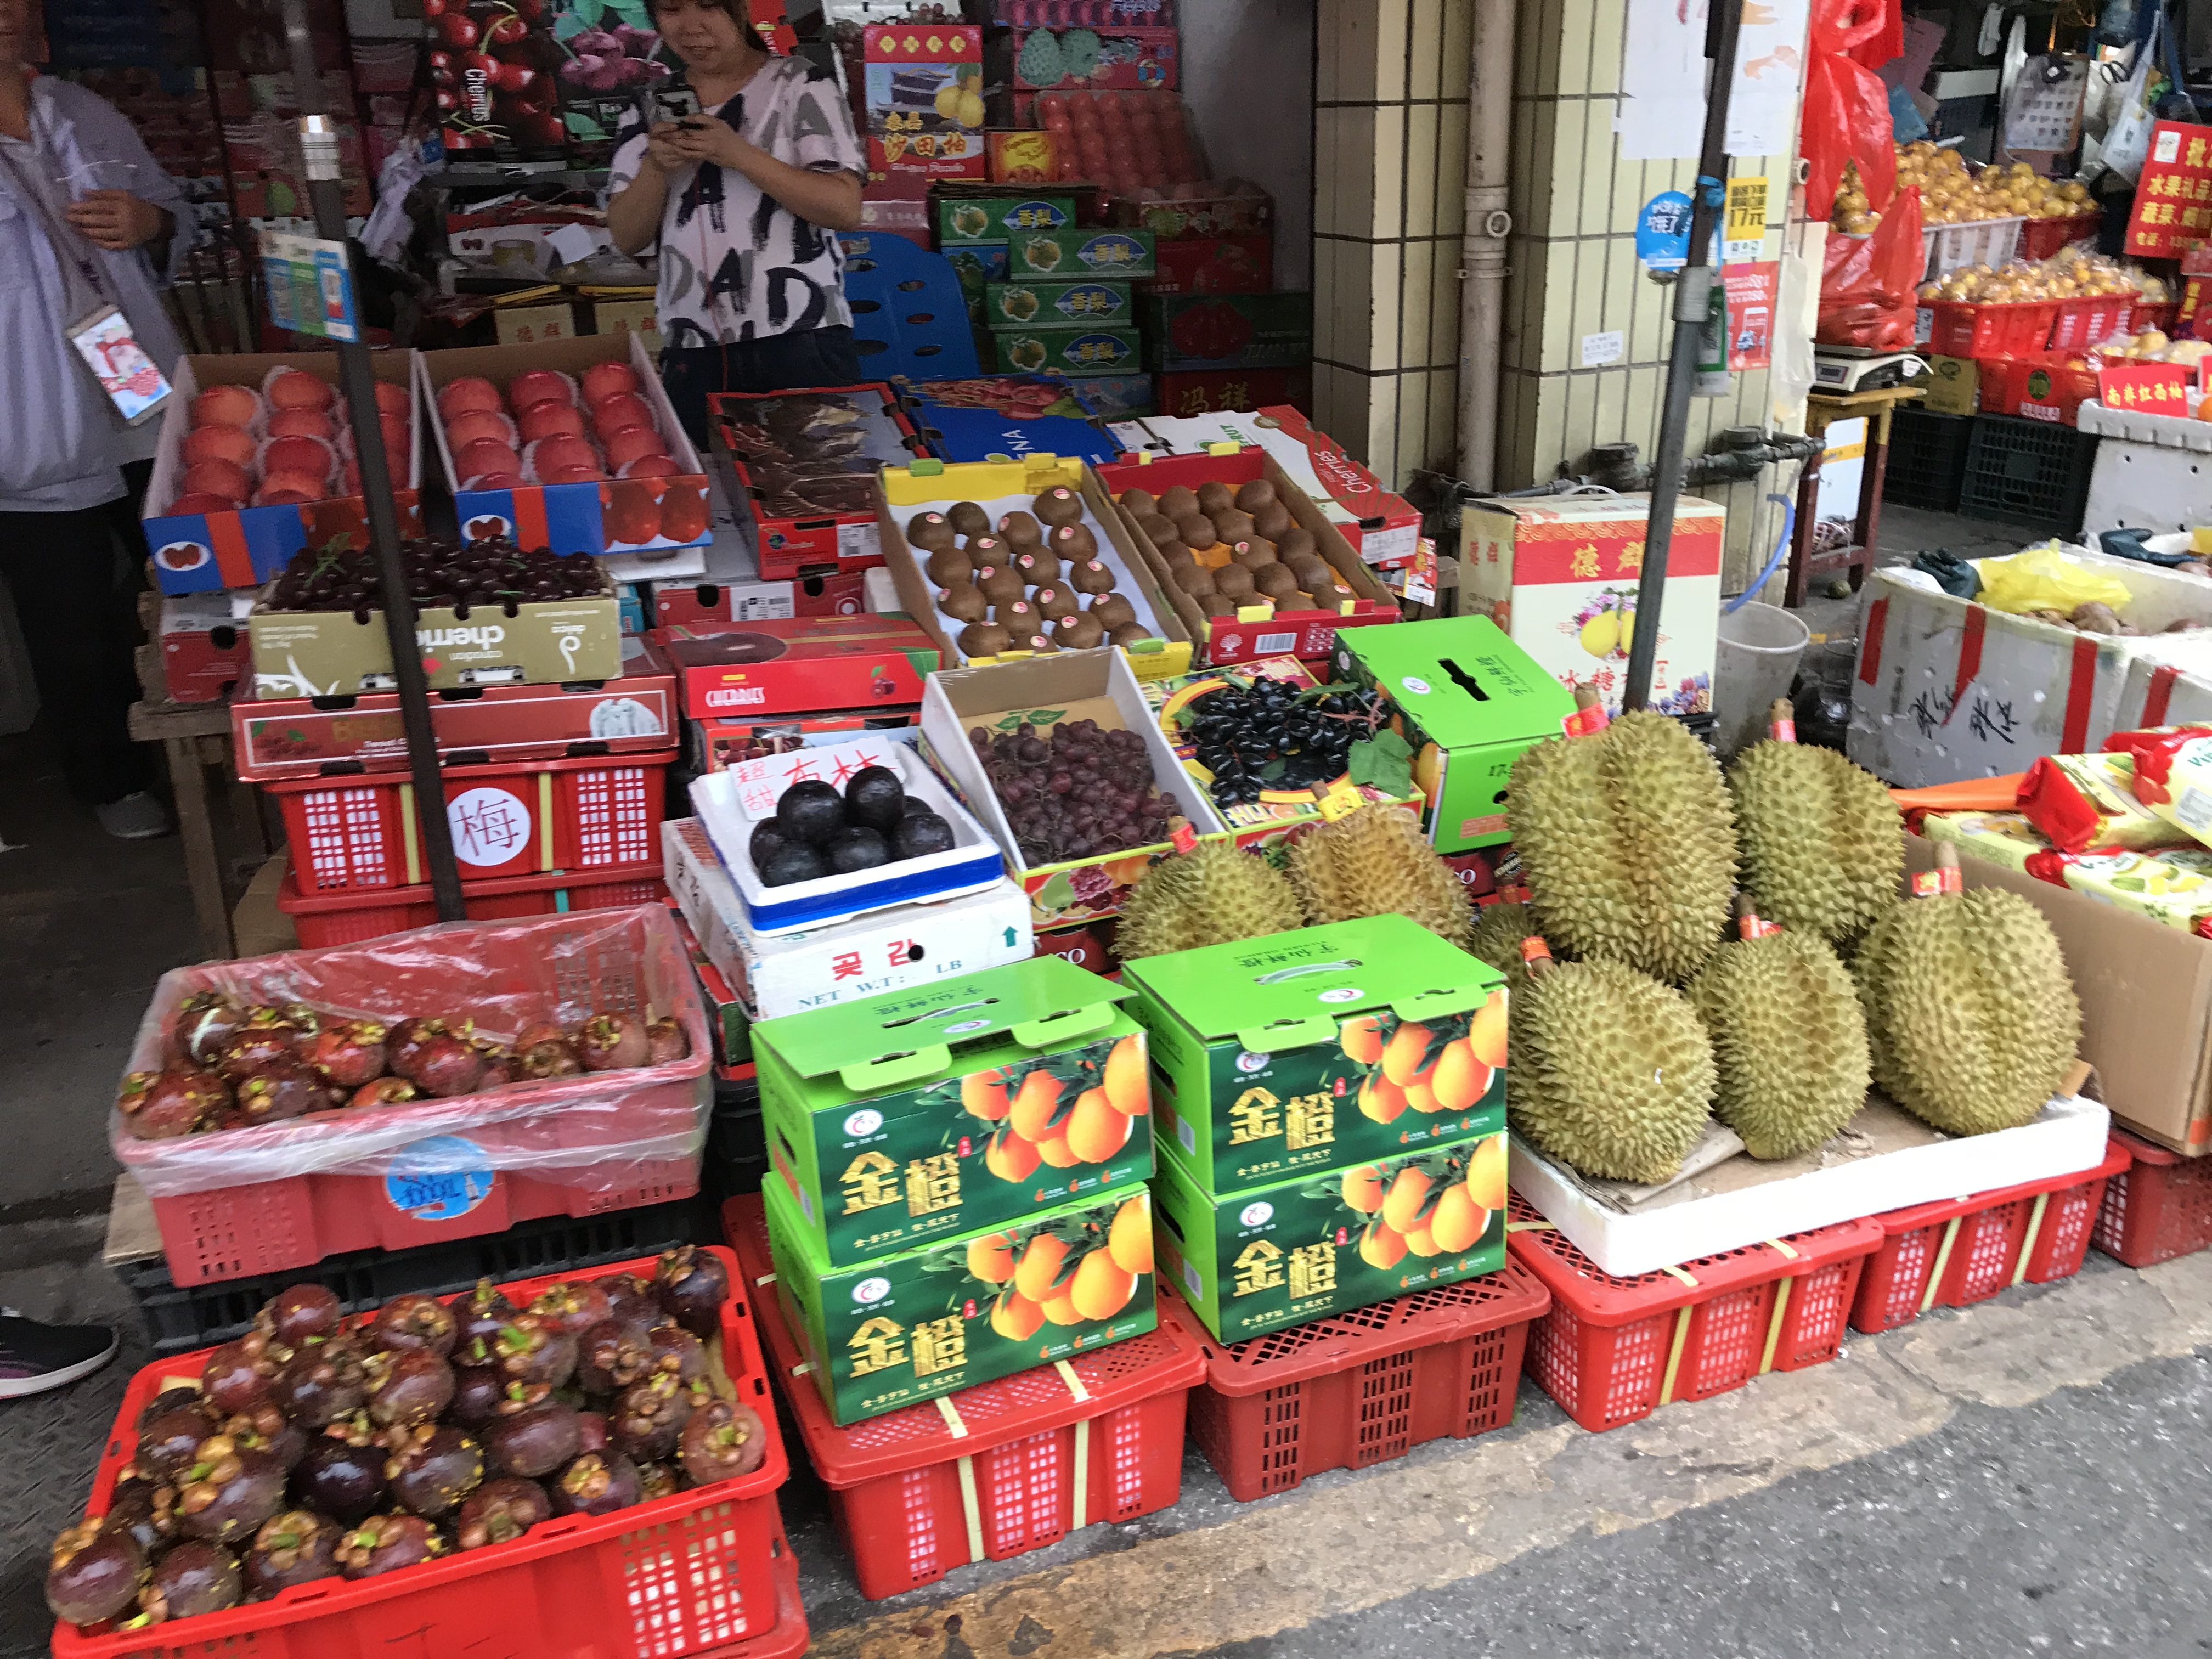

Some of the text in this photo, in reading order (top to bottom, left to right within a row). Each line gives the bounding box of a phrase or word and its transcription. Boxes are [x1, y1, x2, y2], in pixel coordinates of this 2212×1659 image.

[884, 132, 967, 163] 沙田柚
[1018, 209, 1052, 226] 香梨
[1094, 243, 1131, 261] 香梨
[1071, 291, 1107, 311] 香梨
[1079, 342, 1115, 359] 香梨
[2106, 380, 2183, 407] 南非红西柚
[1314, 450, 1373, 493] Cherries
[454, 799, 521, 857] 梅
[797, 989, 842, 1010] NET
[936, 960, 962, 974] LB
[1227, 1086, 1336, 1152] 金橙
[839, 1150, 964, 1218] 金橙
[1232, 1239, 1338, 1301] 金橙
[845, 1314, 969, 1379] 金橙
